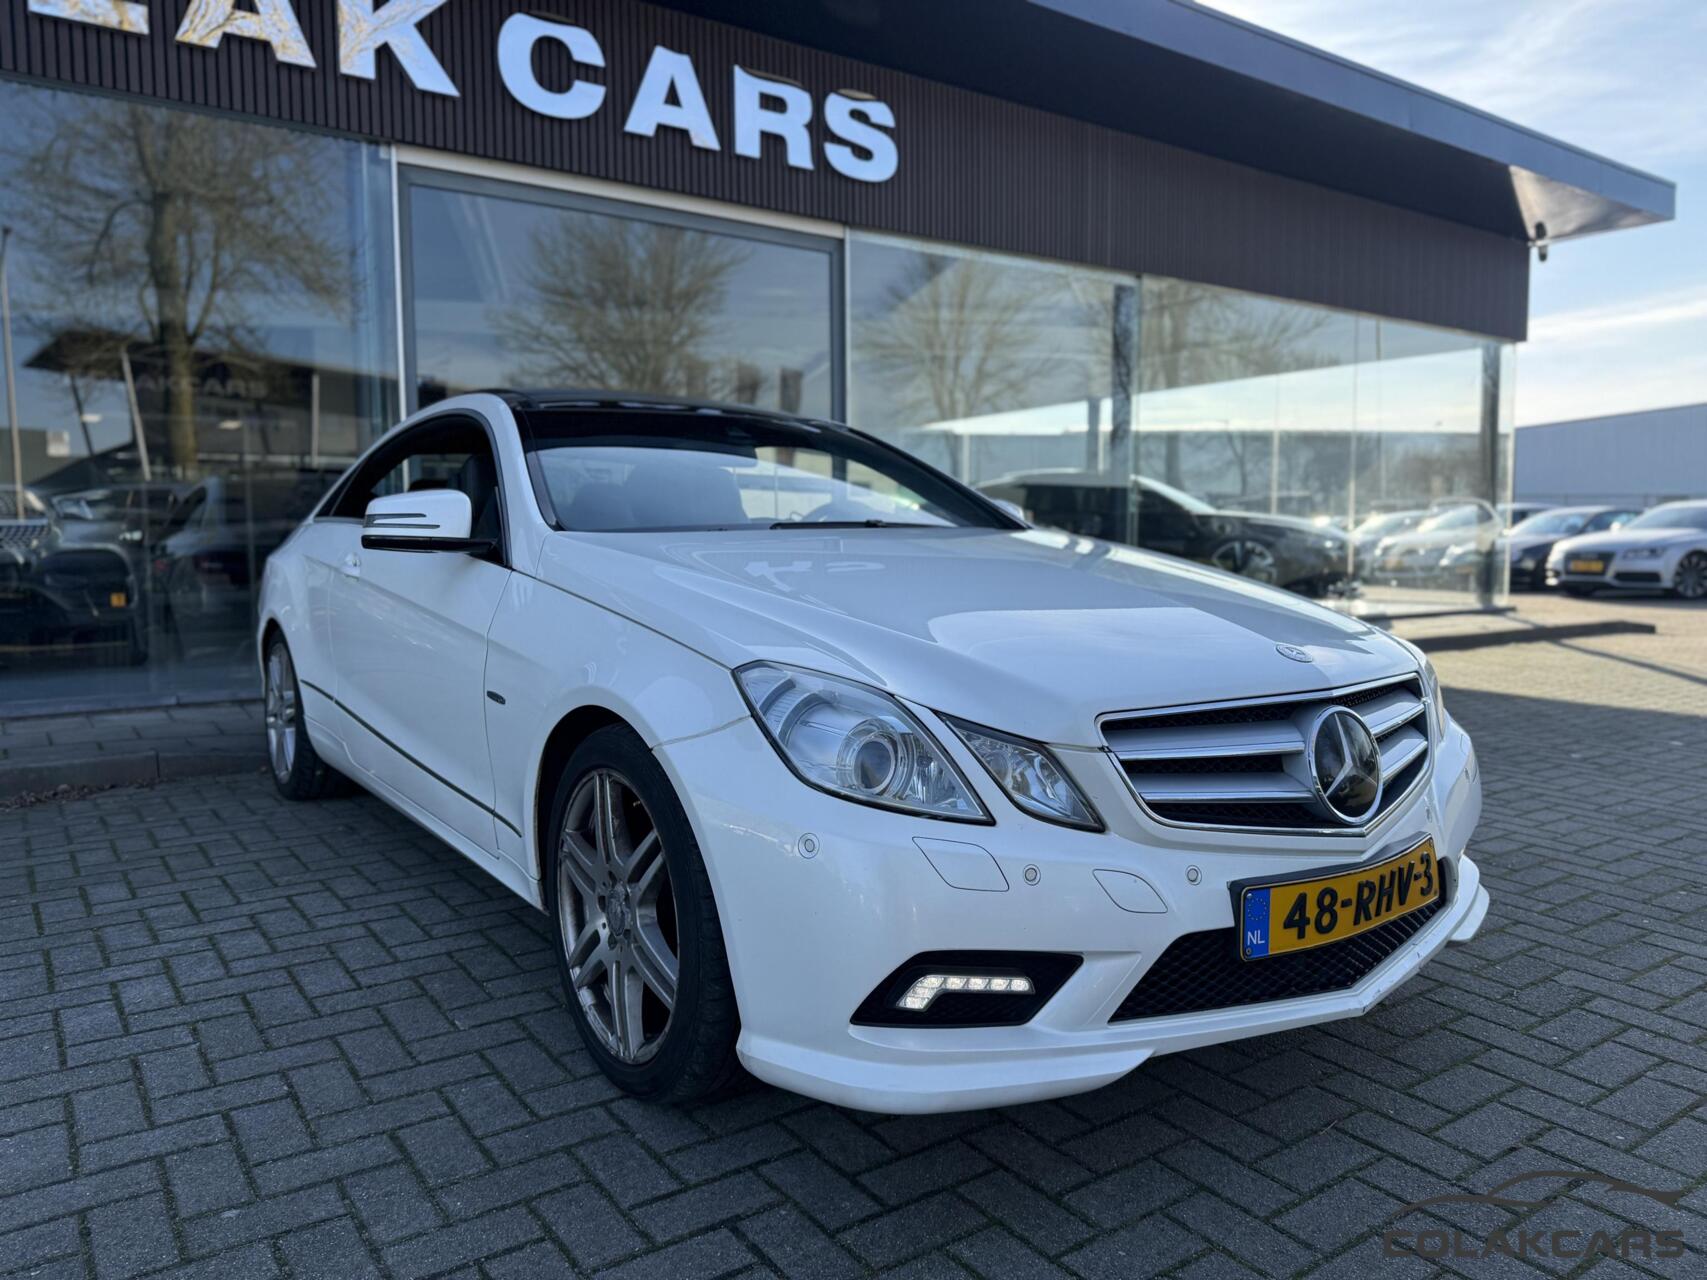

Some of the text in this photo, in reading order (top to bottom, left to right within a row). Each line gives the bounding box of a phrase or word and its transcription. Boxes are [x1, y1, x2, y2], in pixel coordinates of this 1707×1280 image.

[497, 12, 899, 183] CARS
[1247, 930, 1265, 944] NL
[1283, 852, 1433, 940] 48-RHV-3
